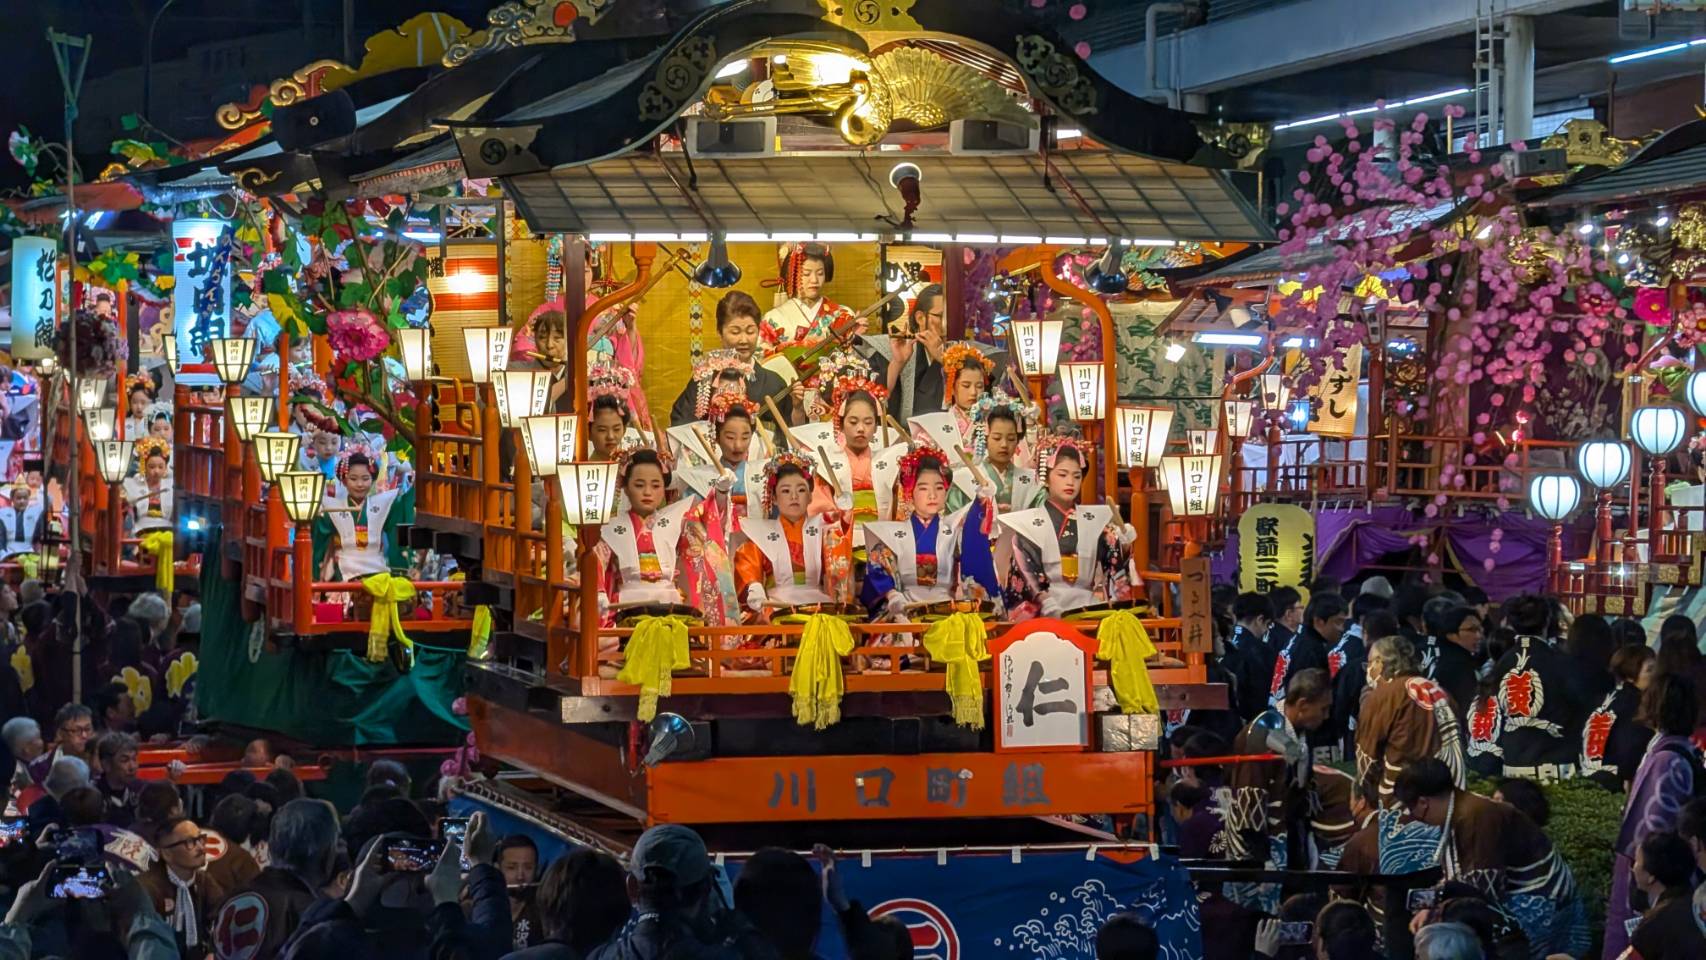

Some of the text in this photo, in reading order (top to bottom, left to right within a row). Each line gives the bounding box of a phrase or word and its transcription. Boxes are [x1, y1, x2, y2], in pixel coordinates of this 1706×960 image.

[493, 331, 506, 371] 川口町
[1023, 325, 1038, 372] 川口町組
[535, 376, 547, 415] 川口町
[1079, 368, 1093, 416] 川口町組
[1130, 413, 1144, 463] 川口町組
[585, 468, 600, 520] 川口町組
[1189, 460, 1204, 511] 川口町組
[1016, 661, 1077, 727] 仁
[768, 762, 1051, 813] 川口町組
